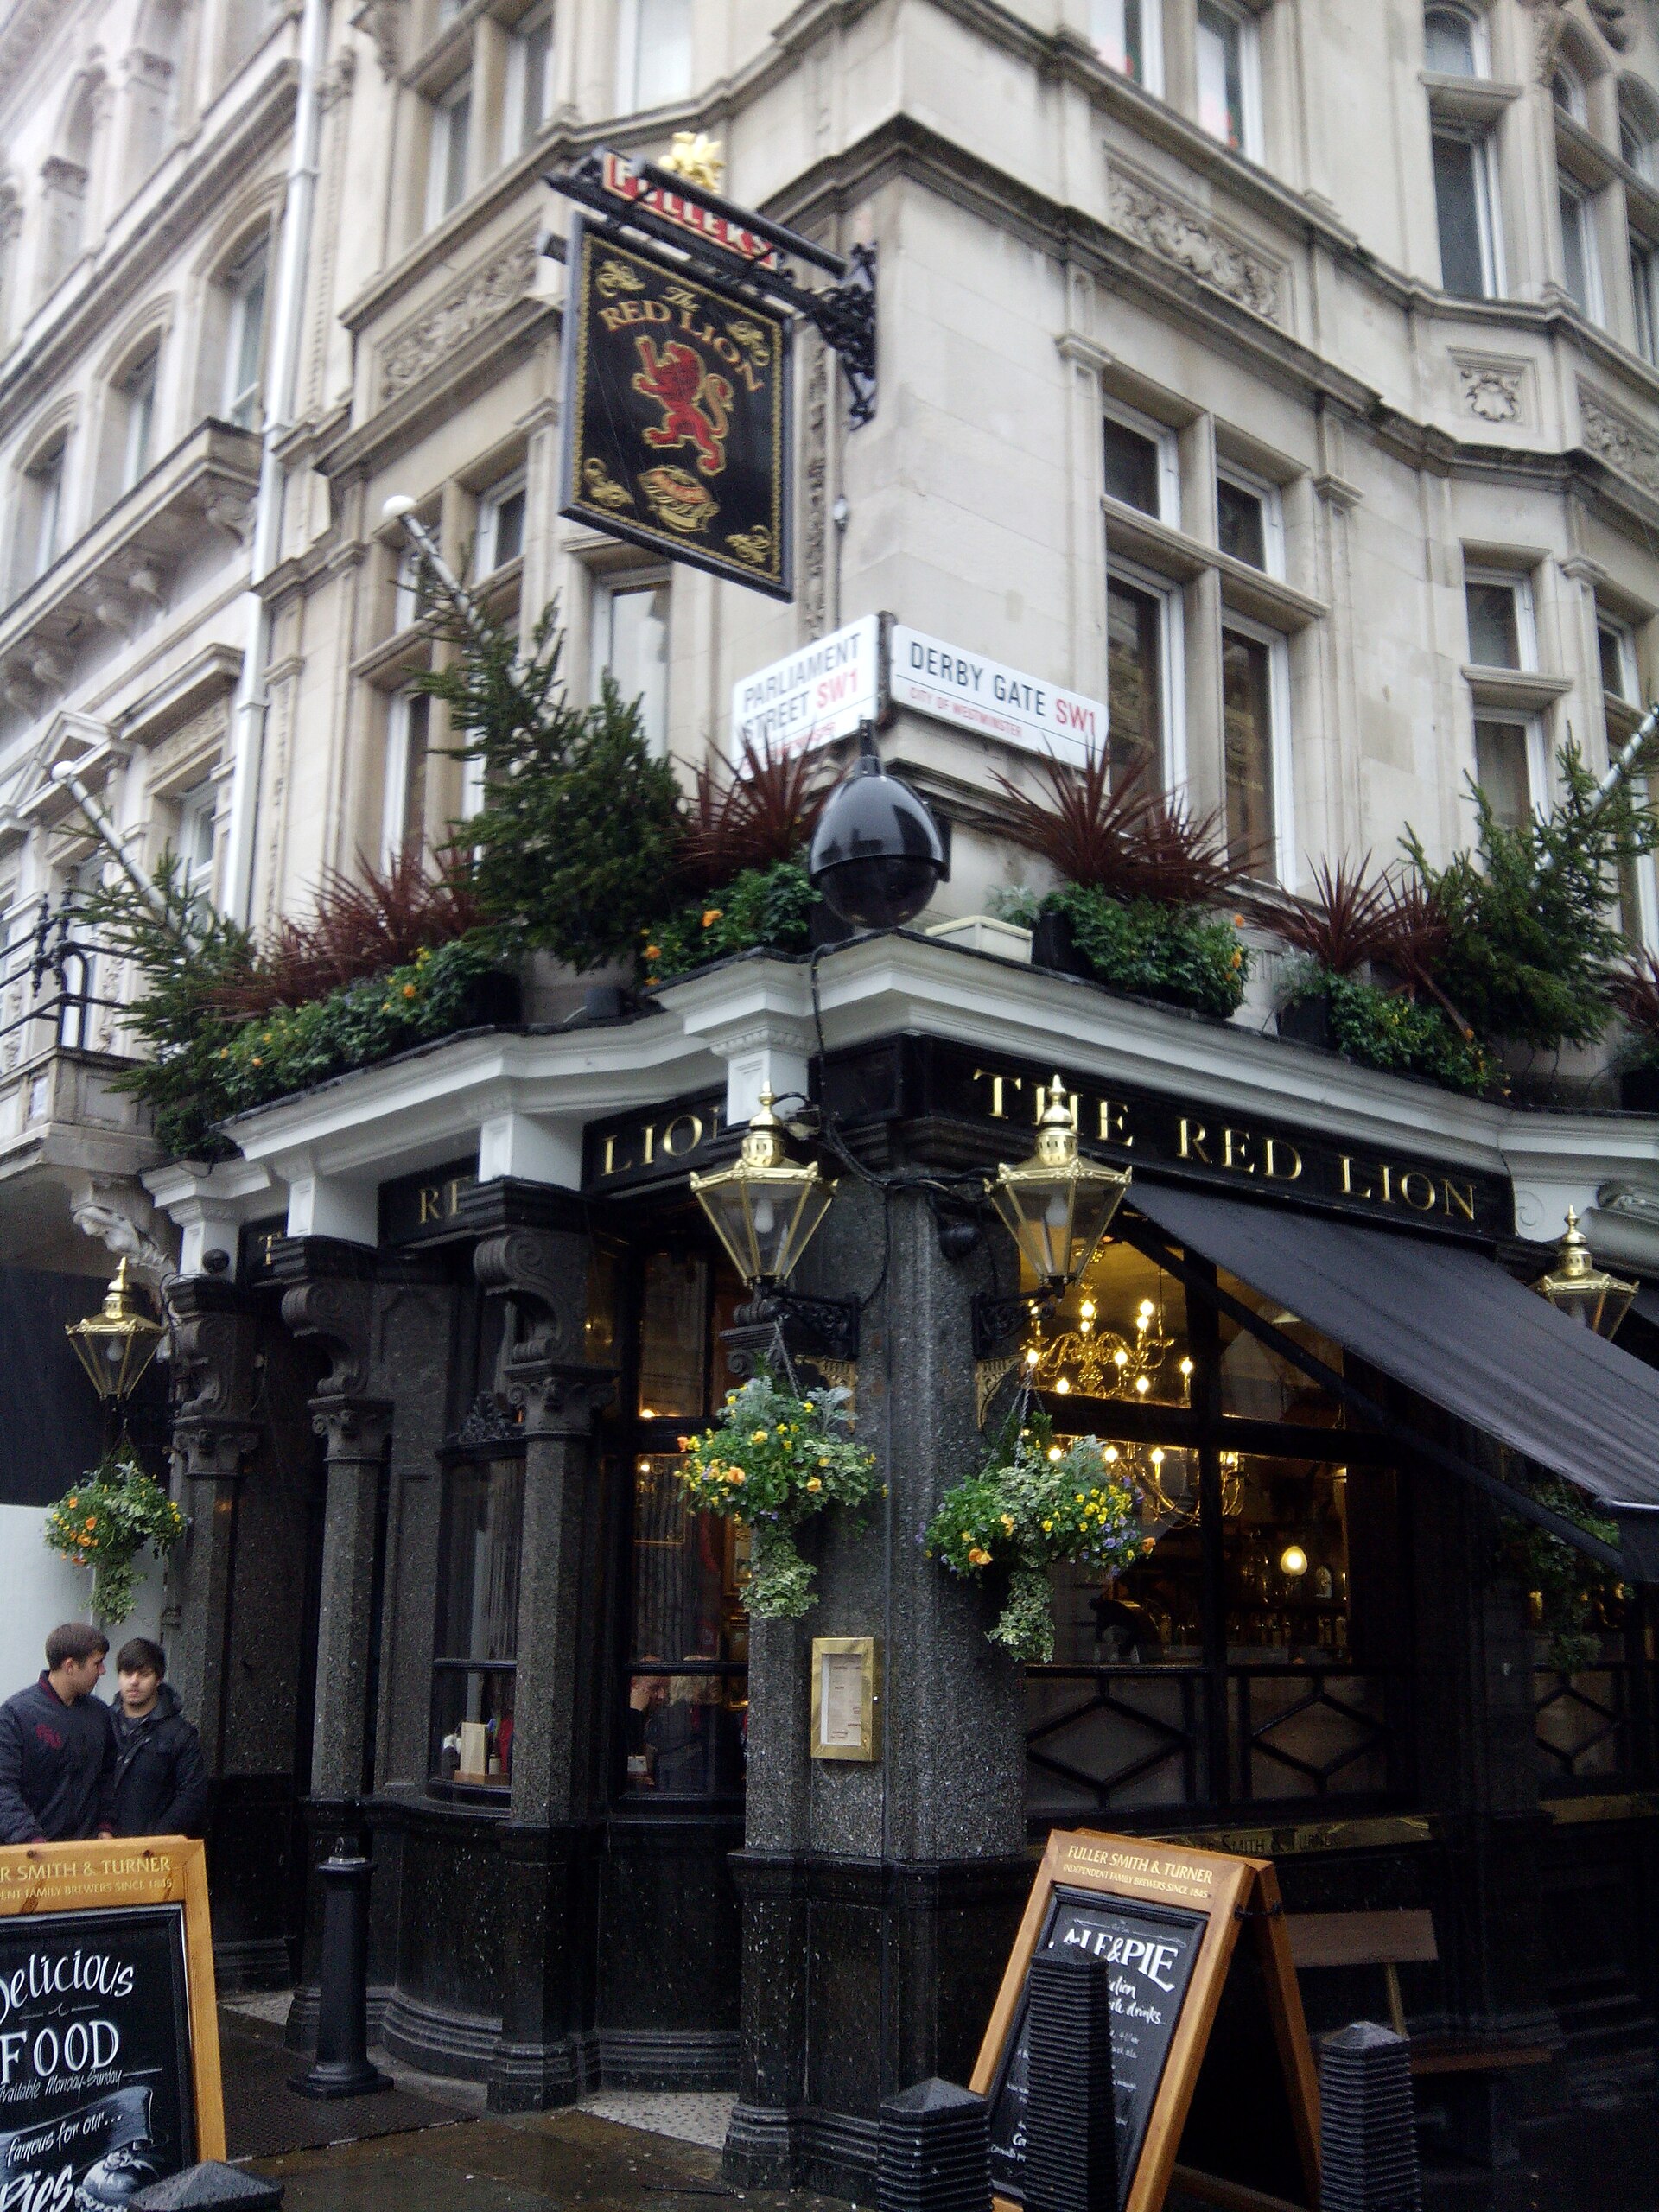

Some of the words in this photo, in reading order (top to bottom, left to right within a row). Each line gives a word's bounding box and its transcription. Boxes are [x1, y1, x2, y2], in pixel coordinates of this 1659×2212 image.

[659, 286, 701, 314] The
[598, 300, 671, 332] RED
[679, 308, 765, 391] LION
[744, 632, 861, 713] PARLIAMENT
[910, 640, 983, 691] DERBY
[994, 674, 1046, 717] GATE
[1056, 698, 1096, 736] SW1
[744, 690, 810, 737] STREET
[817, 668, 858, 709] SW1
[910, 686, 933, 705] CITY
[936, 696, 950, 709] OF
[952, 703, 1023, 737] WESTMINSTER
[973, 1068, 1134, 1147] THE
[1176, 1116, 1303, 1180] RED
[1338, 1154, 1478, 1222] LION
[17, 1862, 77, 1882] SMITH
[83, 1861, 96, 1877] &
[101, 1856, 171, 1875] TURNER
[25, 1885, 62, 1899] FAMILY
[65, 1882, 112, 1895] BREWERS
[115, 1880, 145, 1891] SINCE
[1063, 1864, 1109, 1878] INDEPENDENT
[1109, 1872, 1133, 1885] FAMILY
[1133, 1876, 1166, 1891] BREWERS
[1166, 1883, 1189, 1896] SINCE
[1068, 1845, 1109, 1865] FULLER
[1109, 1853, 1149, 1872] SMITH
[1150, 1860, 1160, 1875] &
[1164, 1862, 1213, 1885] TURNER
[0, 2019, 119, 2085] FOOD
[5, 2131, 54, 2168] famous
[56, 2121, 79, 2152] for
